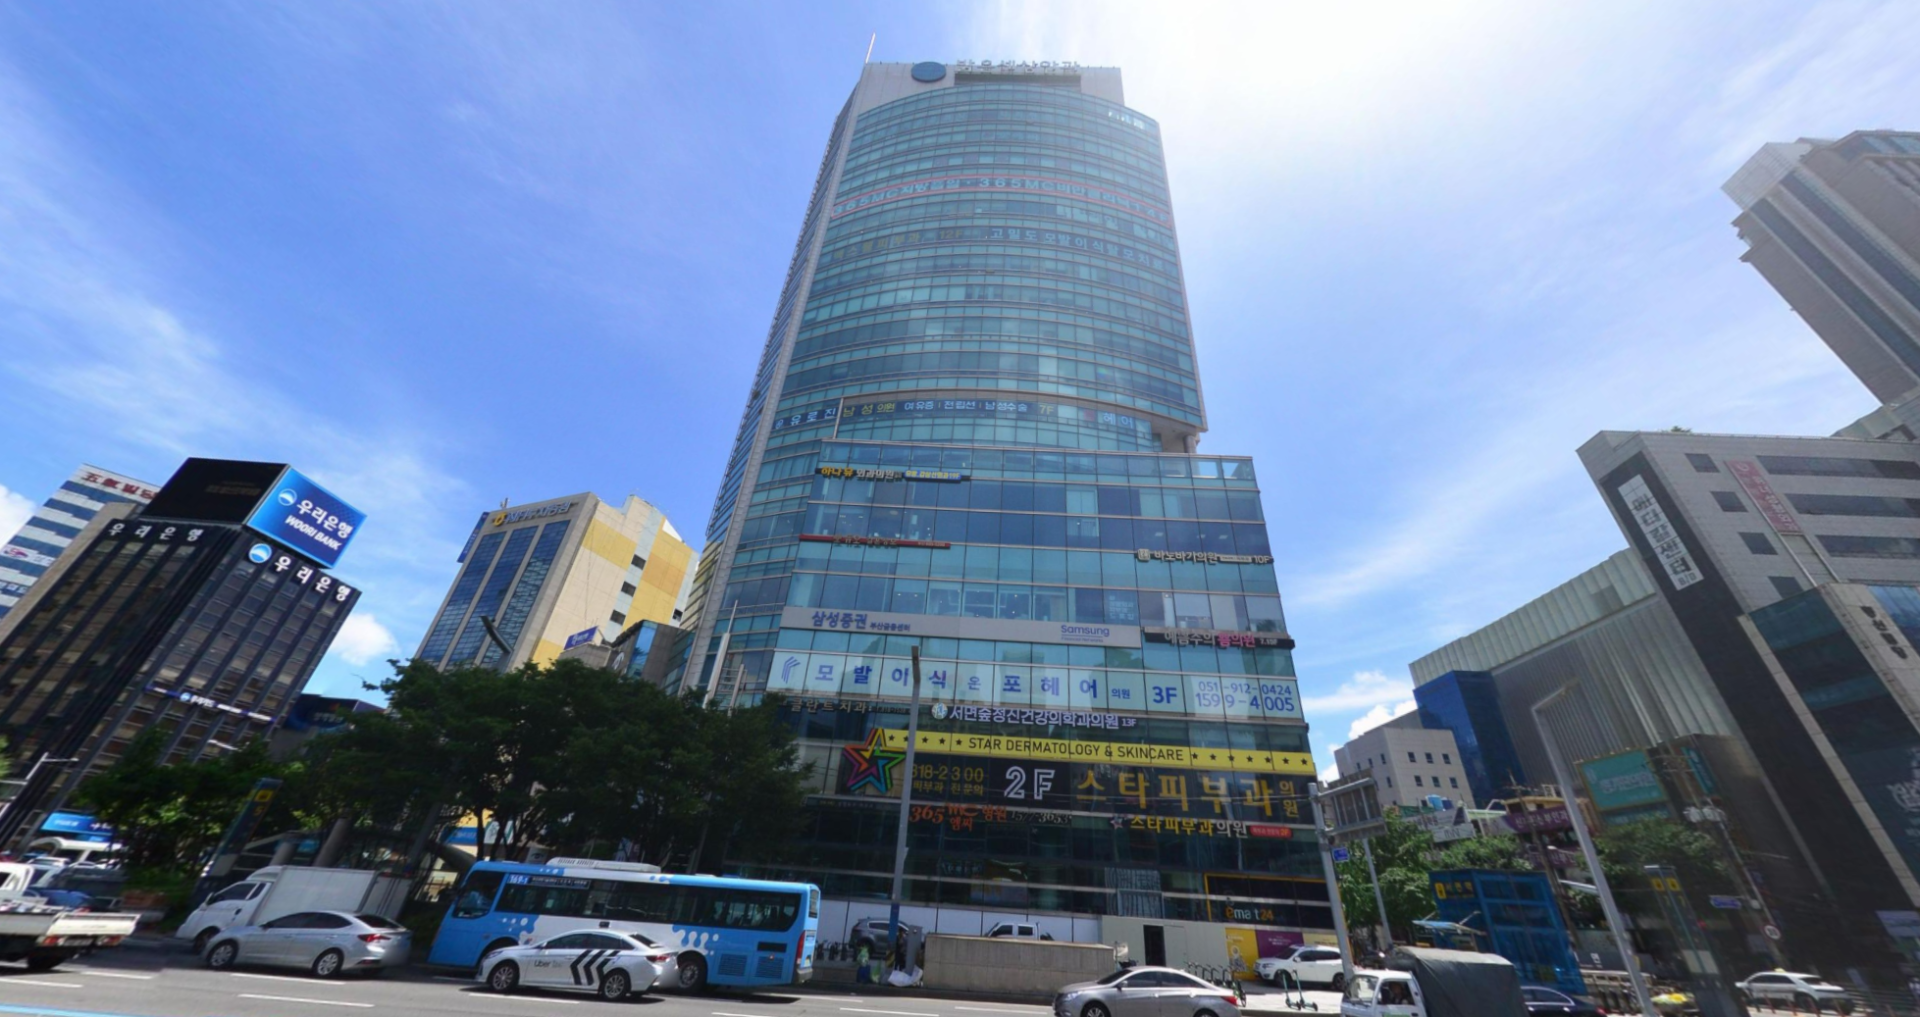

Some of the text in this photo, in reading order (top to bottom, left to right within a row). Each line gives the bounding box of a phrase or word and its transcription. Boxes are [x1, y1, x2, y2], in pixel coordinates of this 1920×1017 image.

[789, 400, 1054, 426] 유로진 남성의원 여유증 전립선 남성수술 7F
[297, 499, 355, 539] 우리은행
[108, 522, 205, 542] 우리은행
[285, 514, 342, 551] WOORI BANK
[1153, 550, 1218, 565] 바노바기의원
[1252, 554, 1271, 565] 10F
[274, 555, 352, 602] 우리은행
[811, 610, 868, 629] 삼성증권
[1060, 623, 1110, 637] Samsung
[1111, 687, 1131, 700] 의원
[1152, 685, 1178, 704] 3F
[1198, 680, 1292, 696] 051-912-0424
[1195, 692, 1295, 712] 1599-4005
[949, 704, 1137, 730] 서면숲정신건강의학과의원 13F
[968, 736, 1184, 762] STAR DERMATOLOGY & SKINCARE
[1004, 765, 1056, 801] 2F
[1076, 766, 1299, 818] 스타피부과 의원
[908, 804, 945, 825] 365
[1130, 814, 1248, 839] 스타피부과의원
[1225, 905, 1274, 921] emat24
[533, 959, 551, 968] Uber
